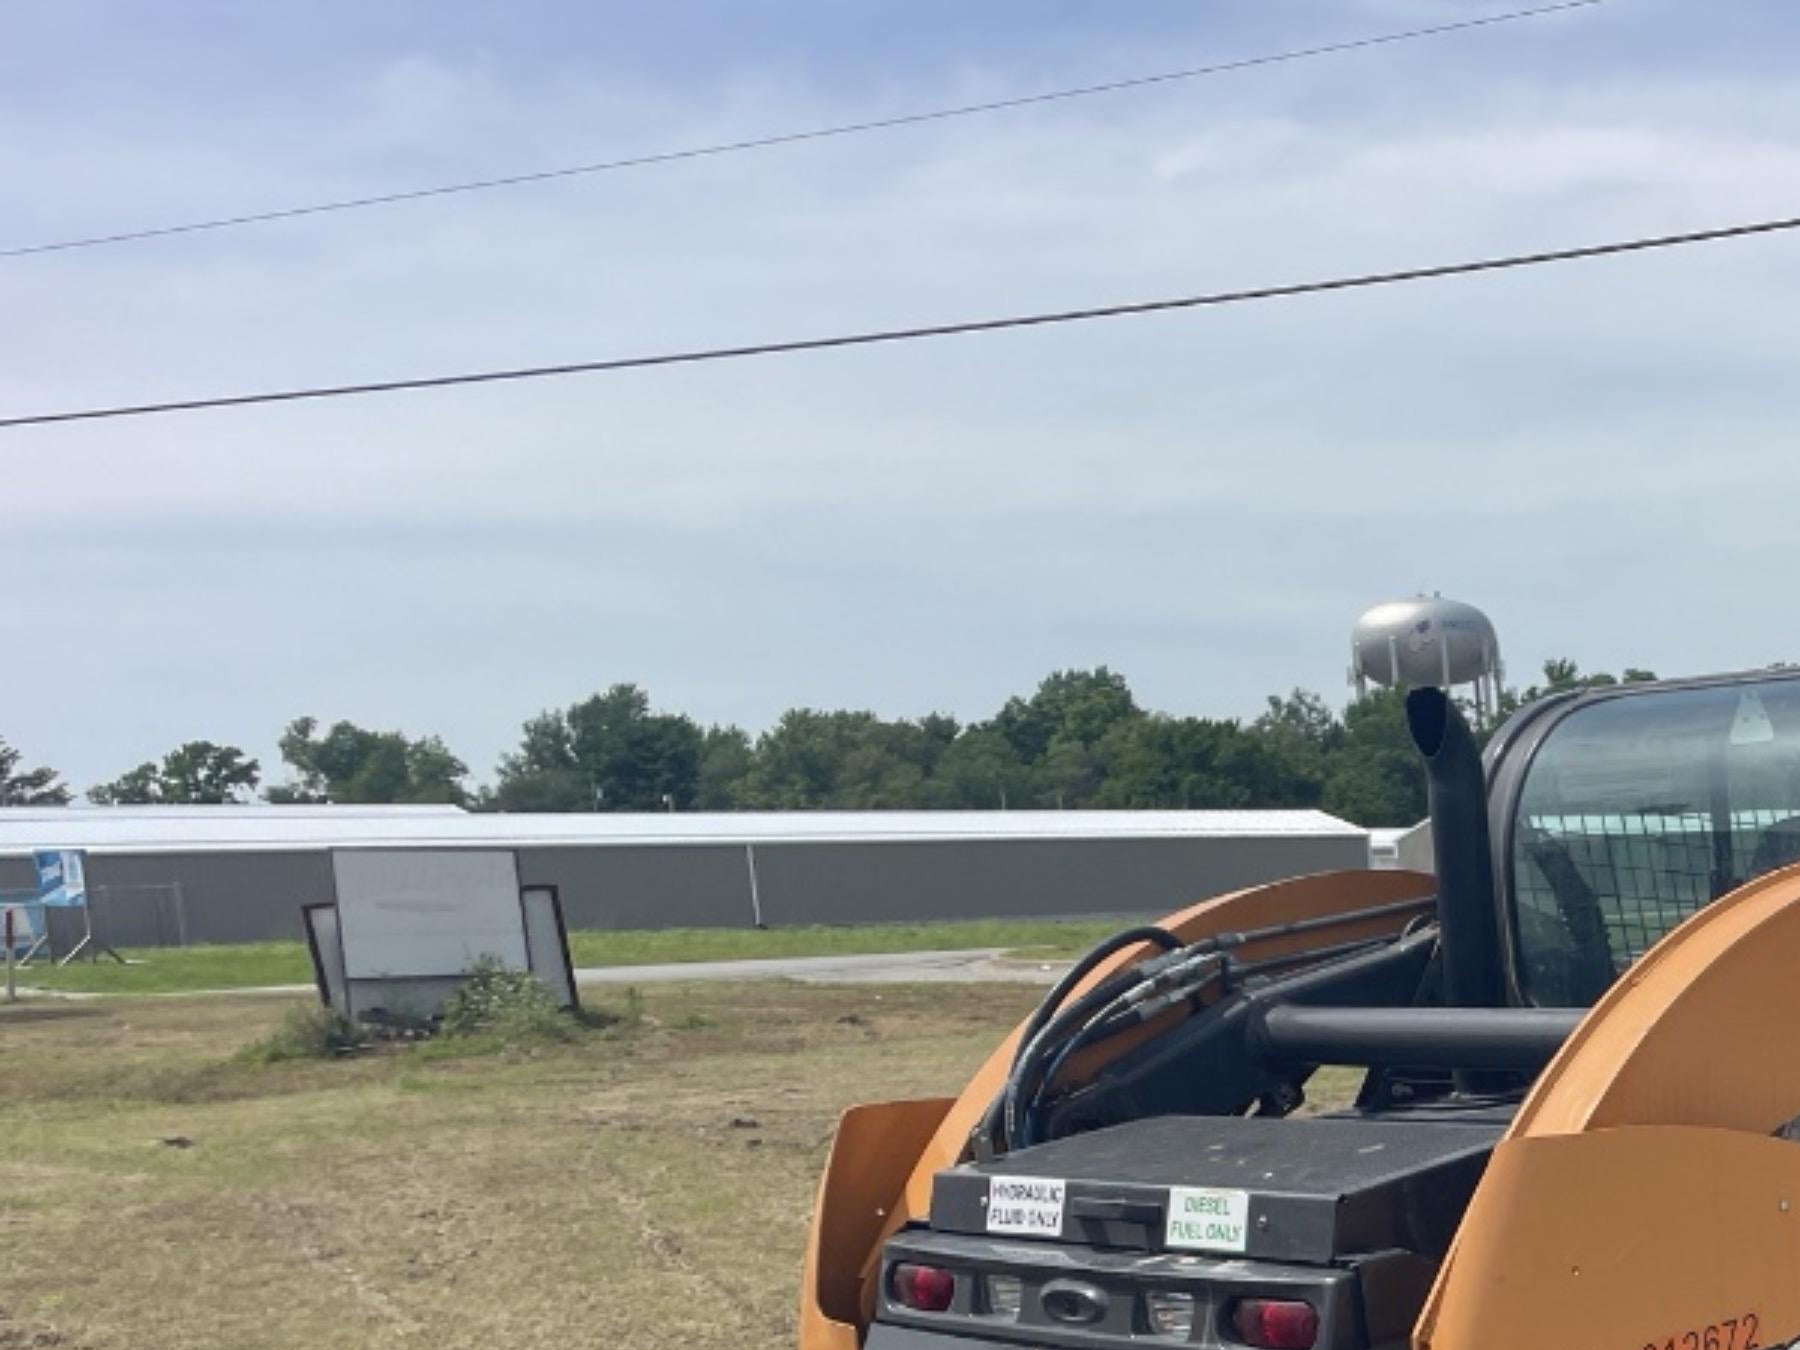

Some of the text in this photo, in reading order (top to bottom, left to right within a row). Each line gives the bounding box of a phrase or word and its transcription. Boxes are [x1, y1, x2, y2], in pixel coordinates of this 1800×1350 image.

[1184, 1196, 1231, 1216] DIESEL
[991, 1207, 1059, 1228] FLUID ONLY
[1170, 1220, 1242, 1243] FUEL ONLY
